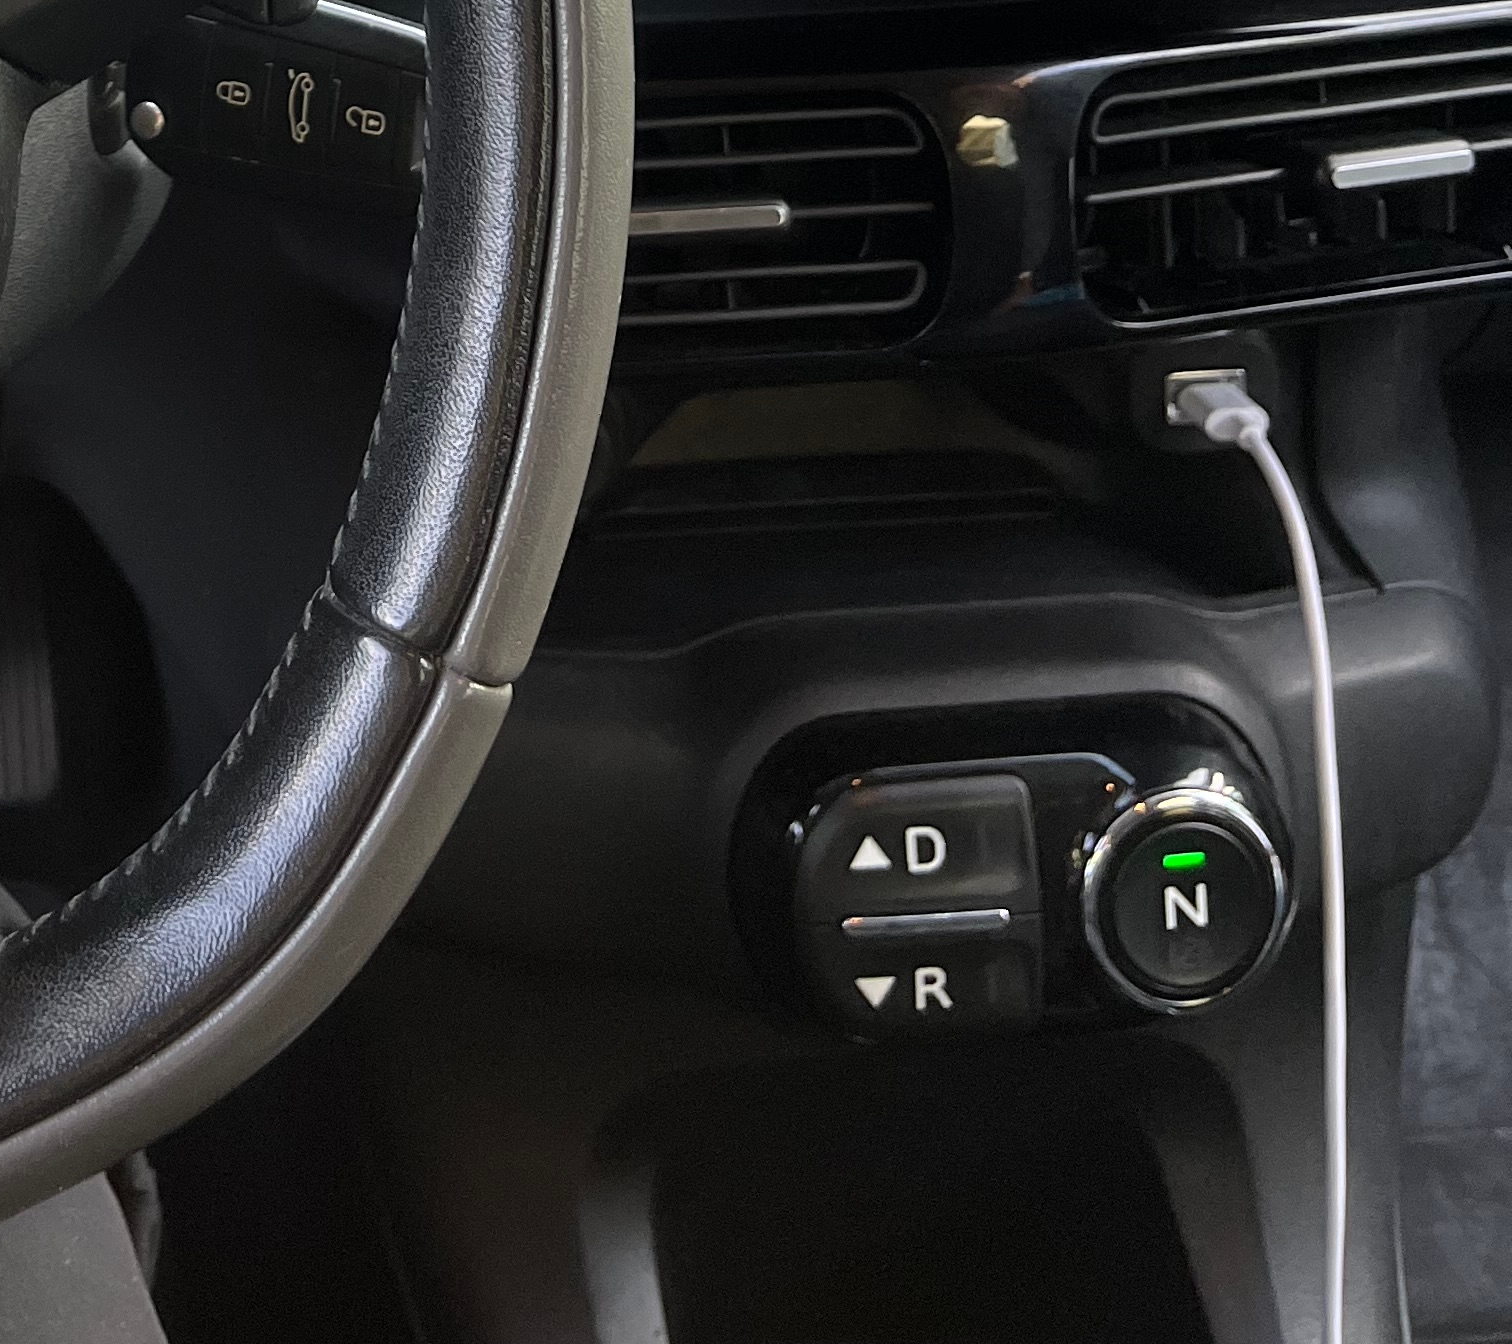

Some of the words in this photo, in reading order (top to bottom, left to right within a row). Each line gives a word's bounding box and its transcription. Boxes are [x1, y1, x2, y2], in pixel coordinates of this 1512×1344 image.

[904, 824, 948, 875] D
[1162, 882, 1211, 931] N
[913, 966, 954, 1011] R
